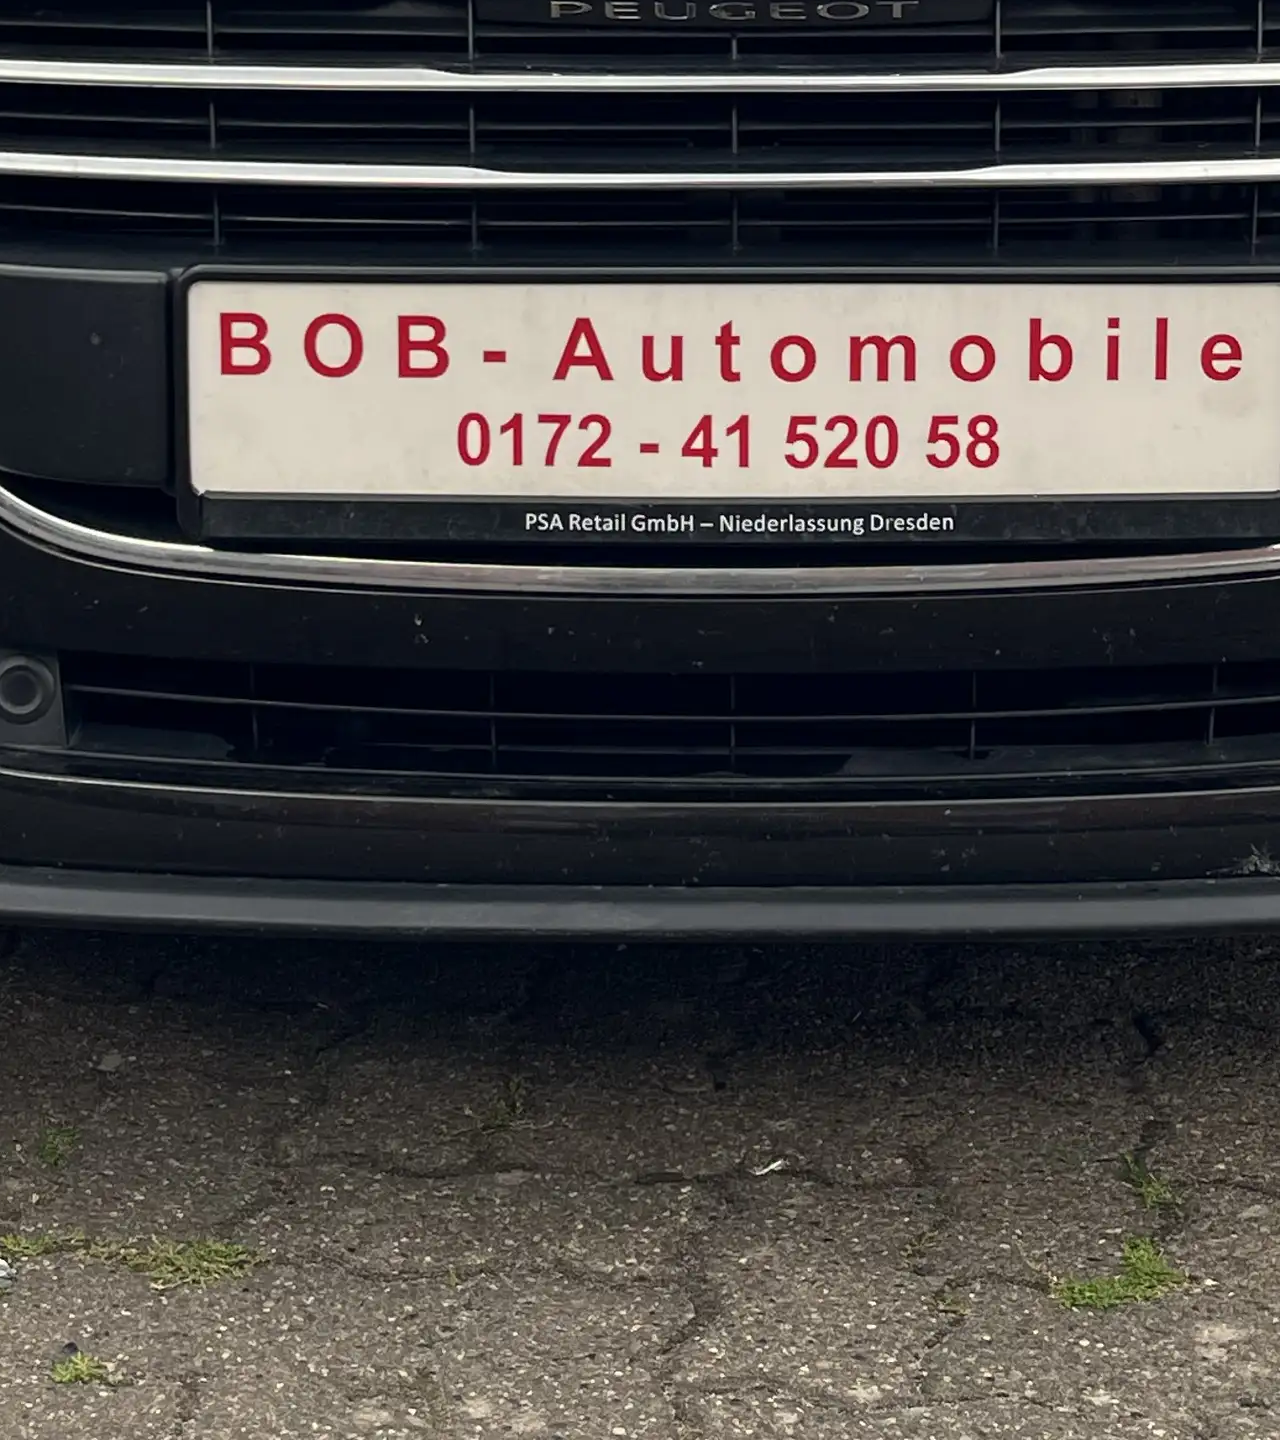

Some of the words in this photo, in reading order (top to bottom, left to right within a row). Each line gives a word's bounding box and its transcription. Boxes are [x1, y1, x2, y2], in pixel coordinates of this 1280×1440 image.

[550, 0, 919, 21] PEUGEOT
[554, 316, 1243, 383] Automobile
[457, 411, 613, 468] 0172
[680, 413, 750, 469] 41
[785, 414, 899, 470] 520
[926, 413, 1000, 469] 58
[525, 513, 564, 531] PSA
[569, 513, 626, 532] Retail
[631, 513, 694, 532] GmbH
[719, 513, 865, 536] Niederlassung
[870, 512, 954, 532] Dresden
